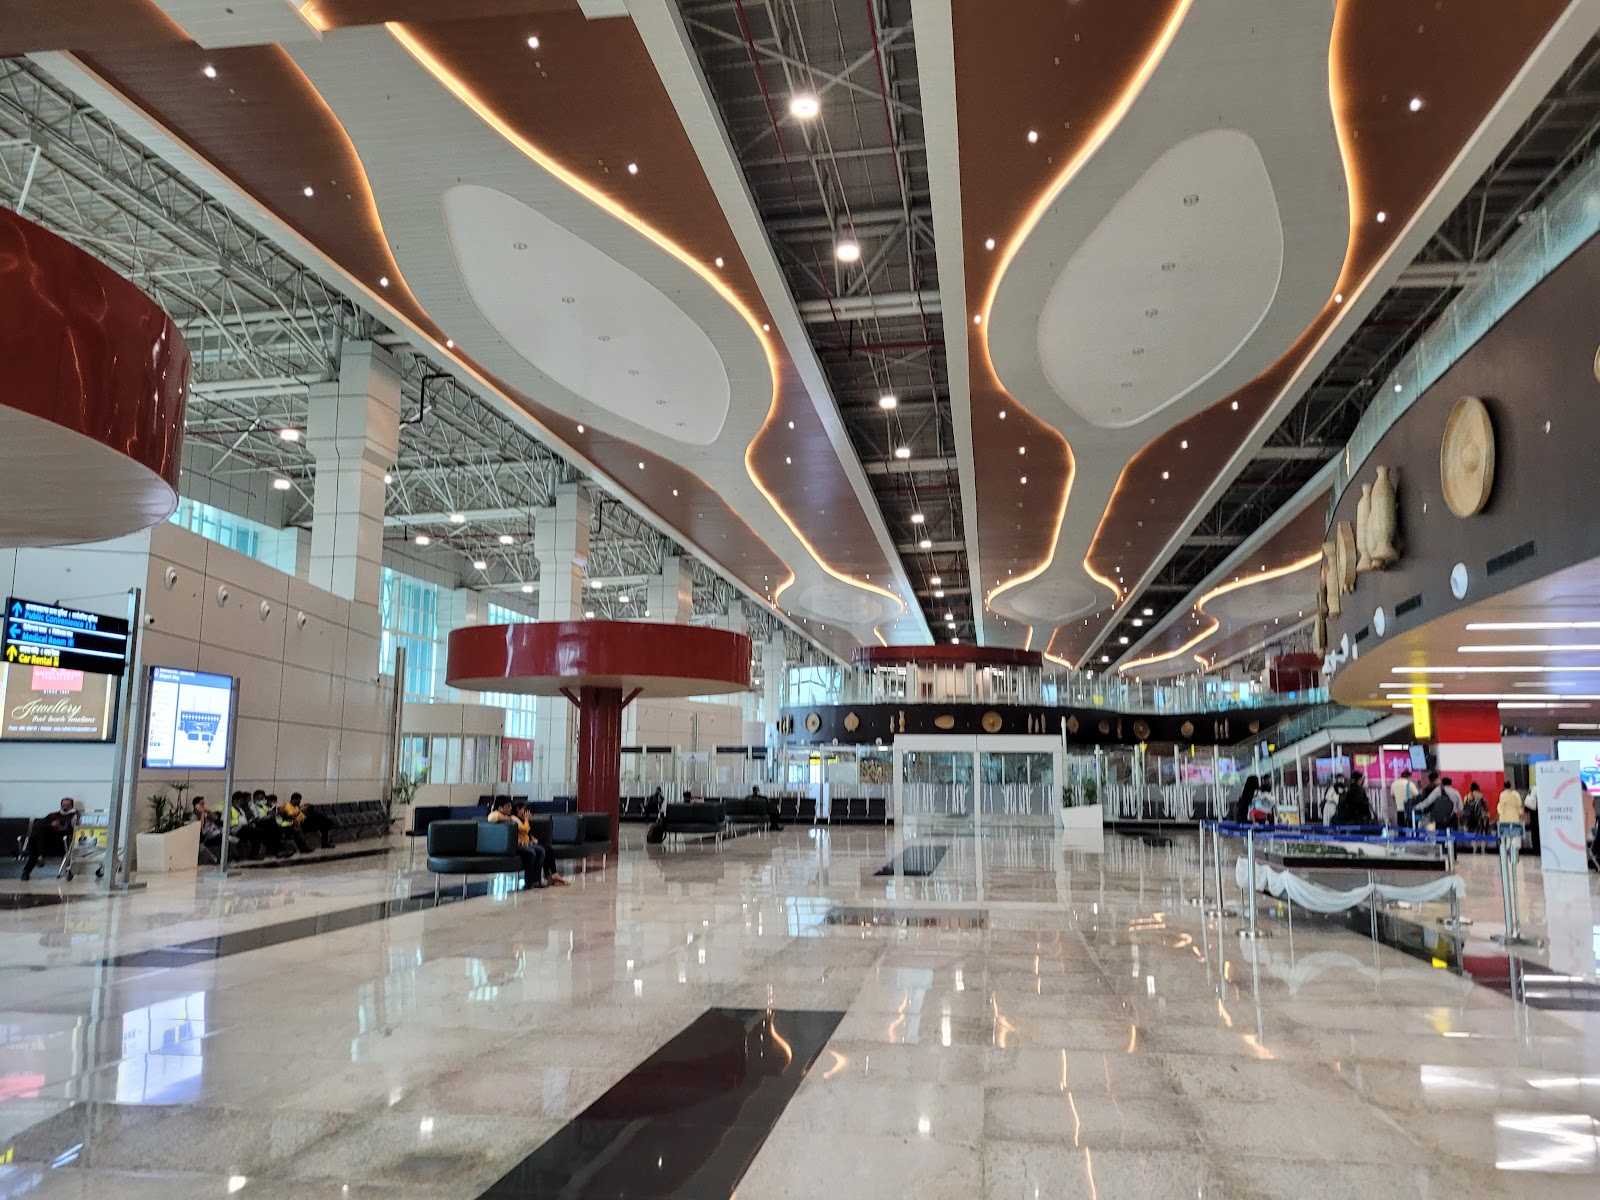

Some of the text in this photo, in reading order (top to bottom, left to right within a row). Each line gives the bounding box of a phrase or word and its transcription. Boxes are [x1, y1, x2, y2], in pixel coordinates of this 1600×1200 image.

[24, 610, 44, 622] Public
[45, 614, 84, 628] Convenience
[22, 631, 48, 644] Medical
[48, 636, 66, 646] Room
[18, 653, 52, 666] Car Rental
[11, 697, 82, 720] Jewellery
[32, 714, 46, 722] that
[48, 714, 66, 723] touch
[1547, 806, 1574, 814] DOMESTIC
